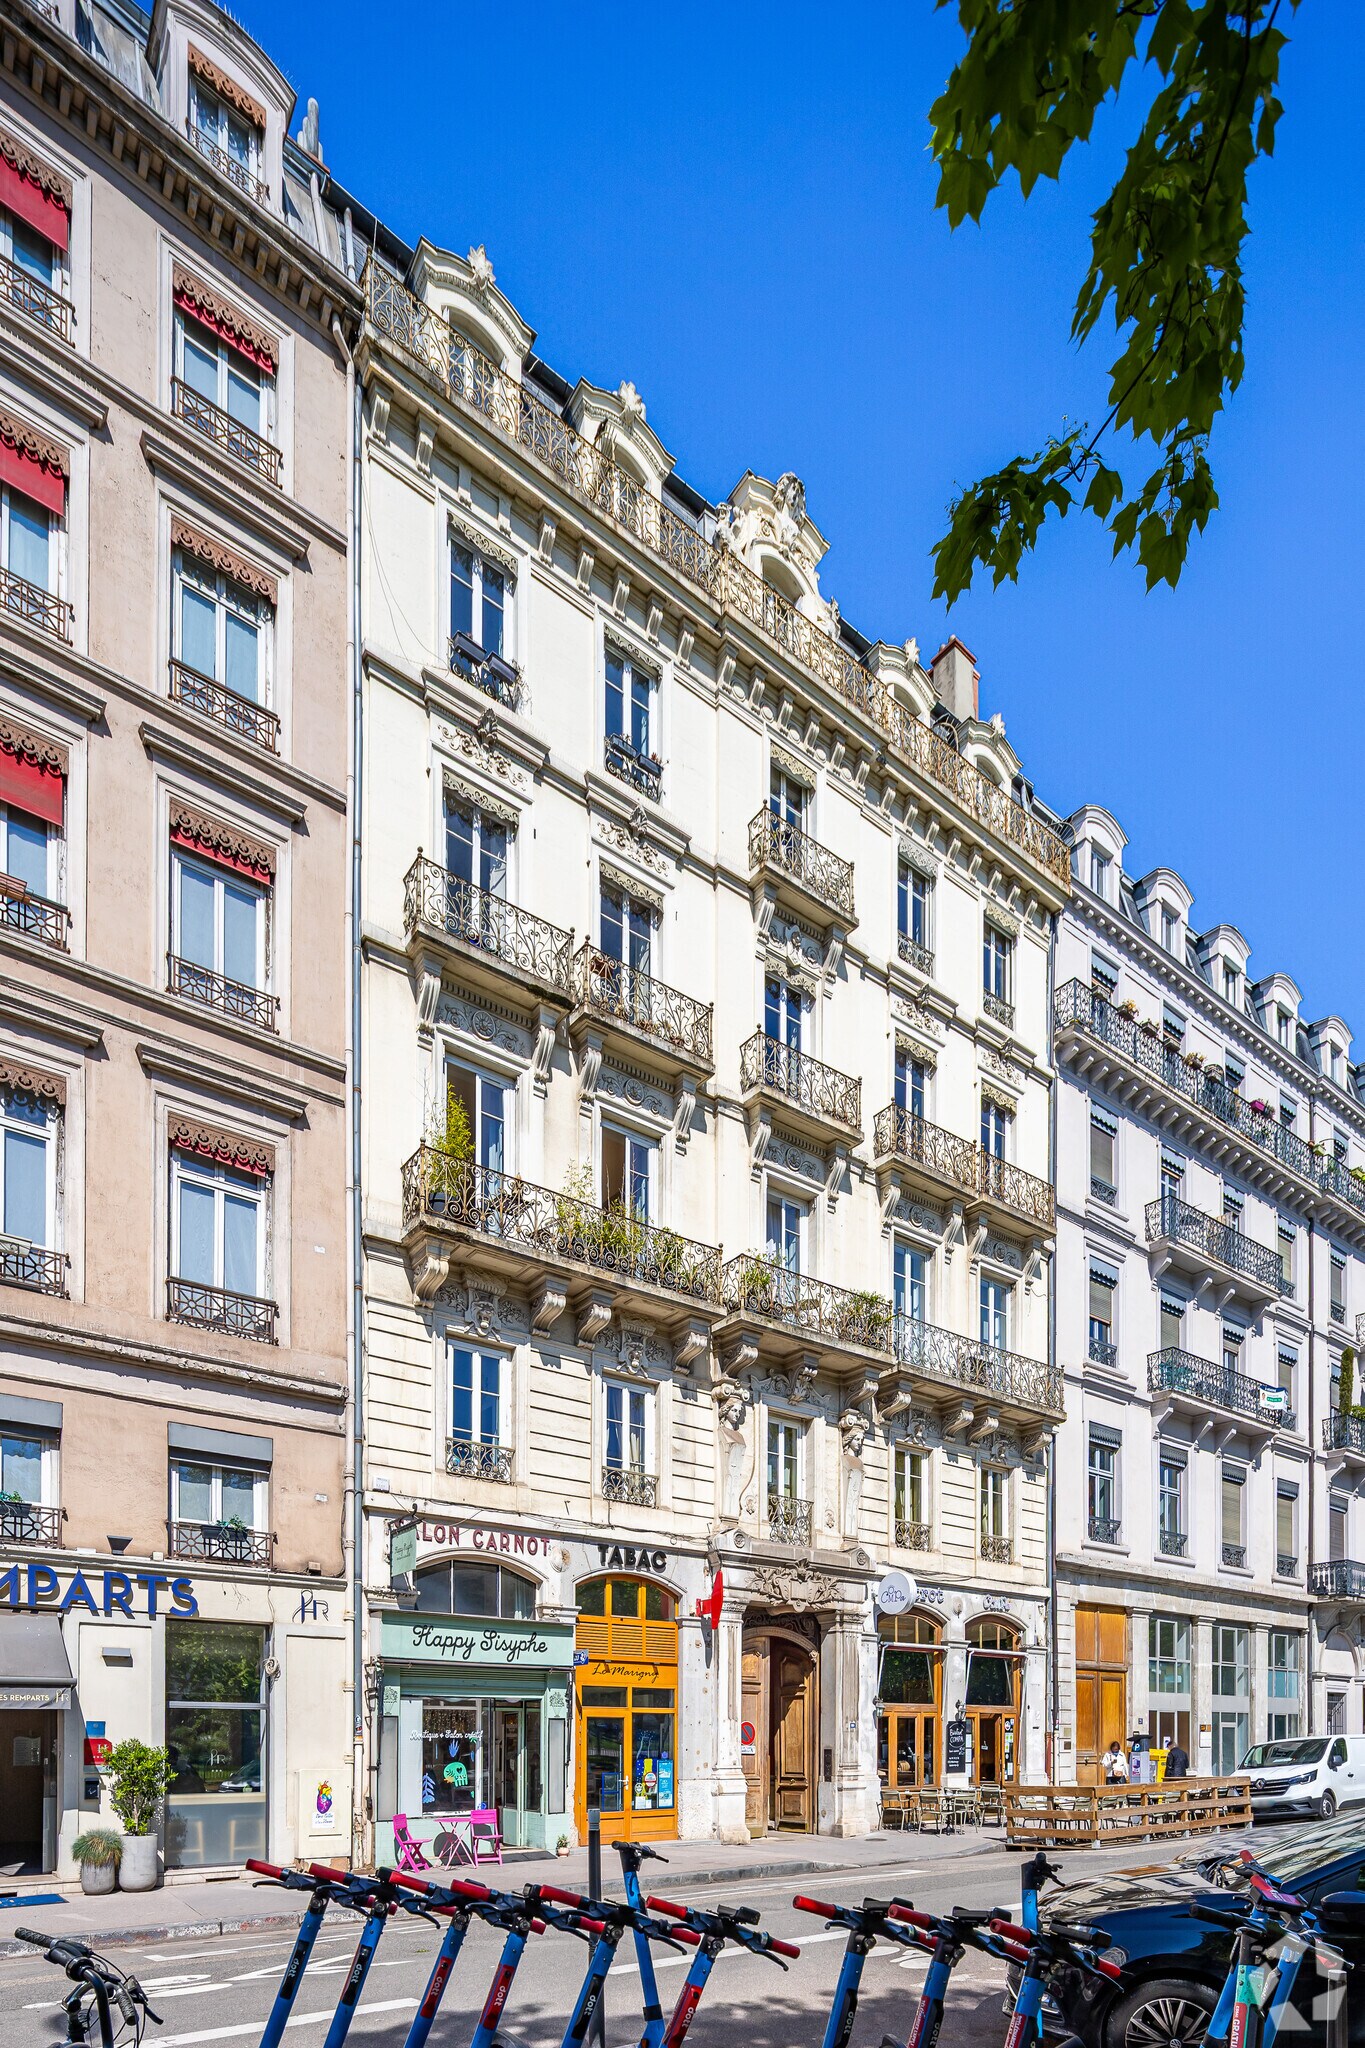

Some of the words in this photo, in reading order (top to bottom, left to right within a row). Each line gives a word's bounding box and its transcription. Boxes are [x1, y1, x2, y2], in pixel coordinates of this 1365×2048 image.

[472, 1528, 550, 1557] CARNOT
[598, 1544, 667, 1570] TABAC
[413, 1625, 475, 1660] Happy
[480, 1629, 548, 1662] Sisyphe
[611, 1666, 659, 1684] Marigny
[1135, 1743, 1140, 1751] P
[288, 1958, 299, 1977] dott
[351, 1963, 362, 1984] dott
[431, 1976, 443, 1996] dott
[494, 1985, 506, 2006] dott
[584, 1995, 596, 2015] dott
[682, 2007, 694, 2028] dott
[844, 2011, 854, 2034] dott
